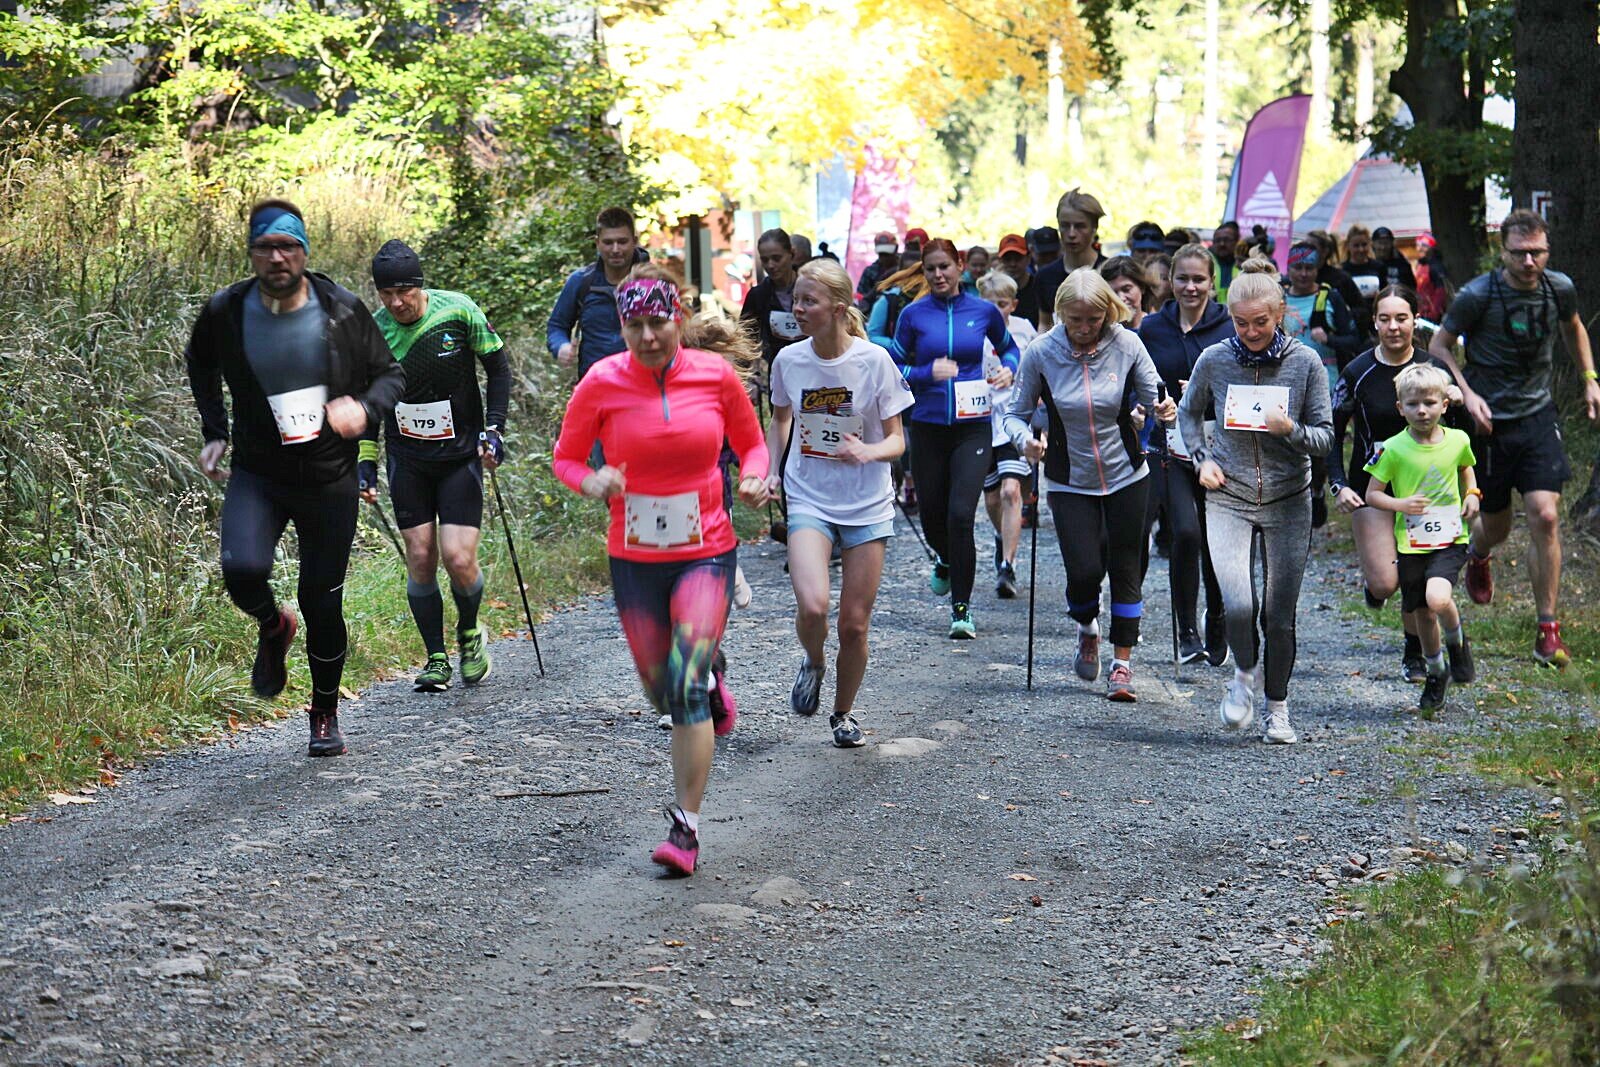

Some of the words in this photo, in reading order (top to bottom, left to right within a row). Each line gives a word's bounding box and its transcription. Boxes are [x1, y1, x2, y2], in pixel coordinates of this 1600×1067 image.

[785, 322, 798, 330] 52
[803, 391, 846, 410] Camp
[971, 396, 987, 406] 173
[1252, 402, 1262, 413] 4
[412, 419, 436, 429] 179
[822, 430, 840, 442] 25
[1424, 521, 1442, 533] 65
